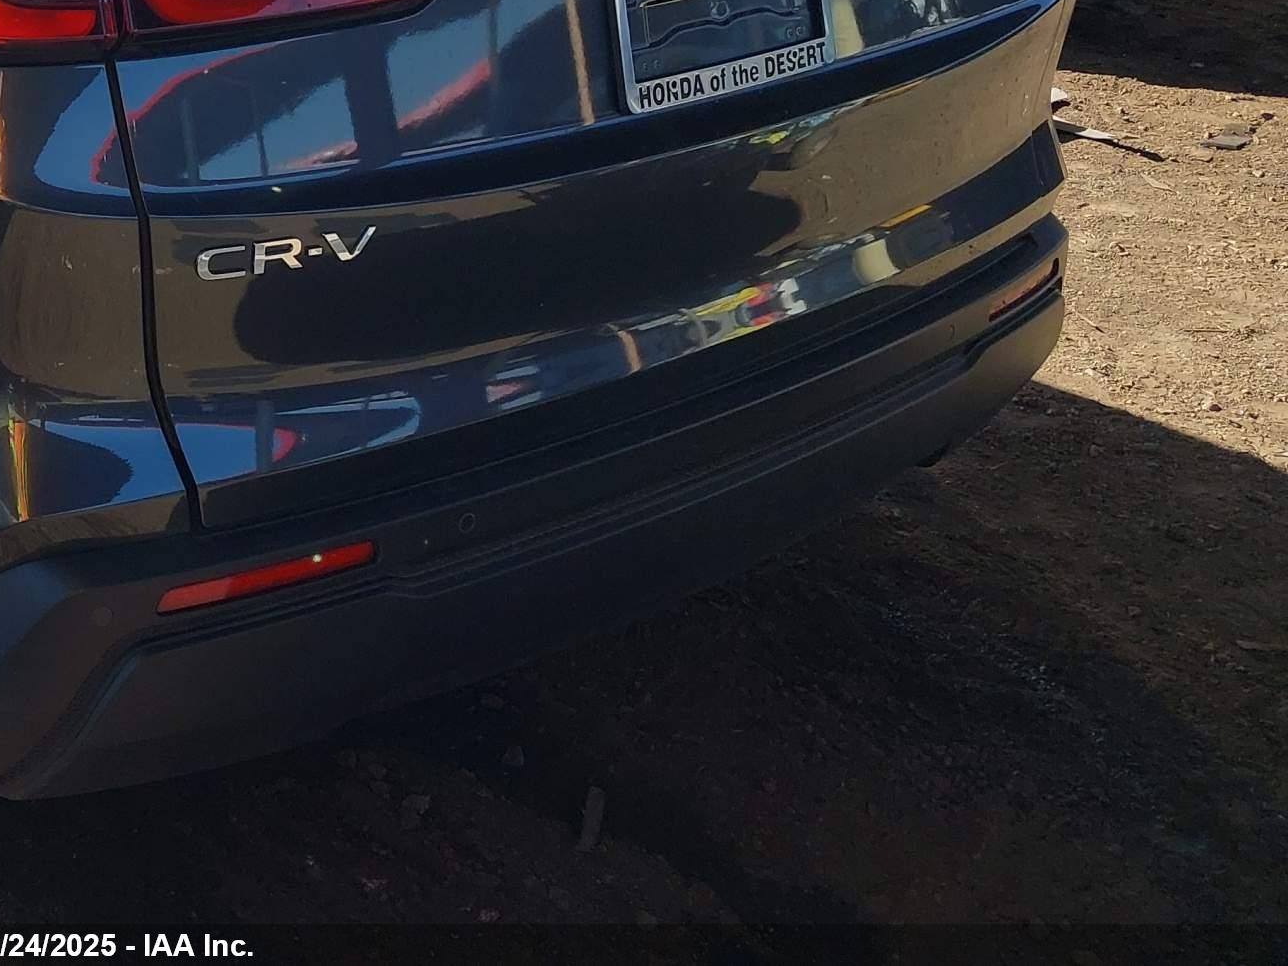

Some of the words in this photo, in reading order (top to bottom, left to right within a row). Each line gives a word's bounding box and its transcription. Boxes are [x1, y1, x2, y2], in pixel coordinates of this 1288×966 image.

[638, 73, 705, 109] HONDA
[711, 67, 727, 92] of
[731, 64, 759, 87] the
[764, 41, 826, 78] DESERT
[196, 225, 377, 281] CR-V
